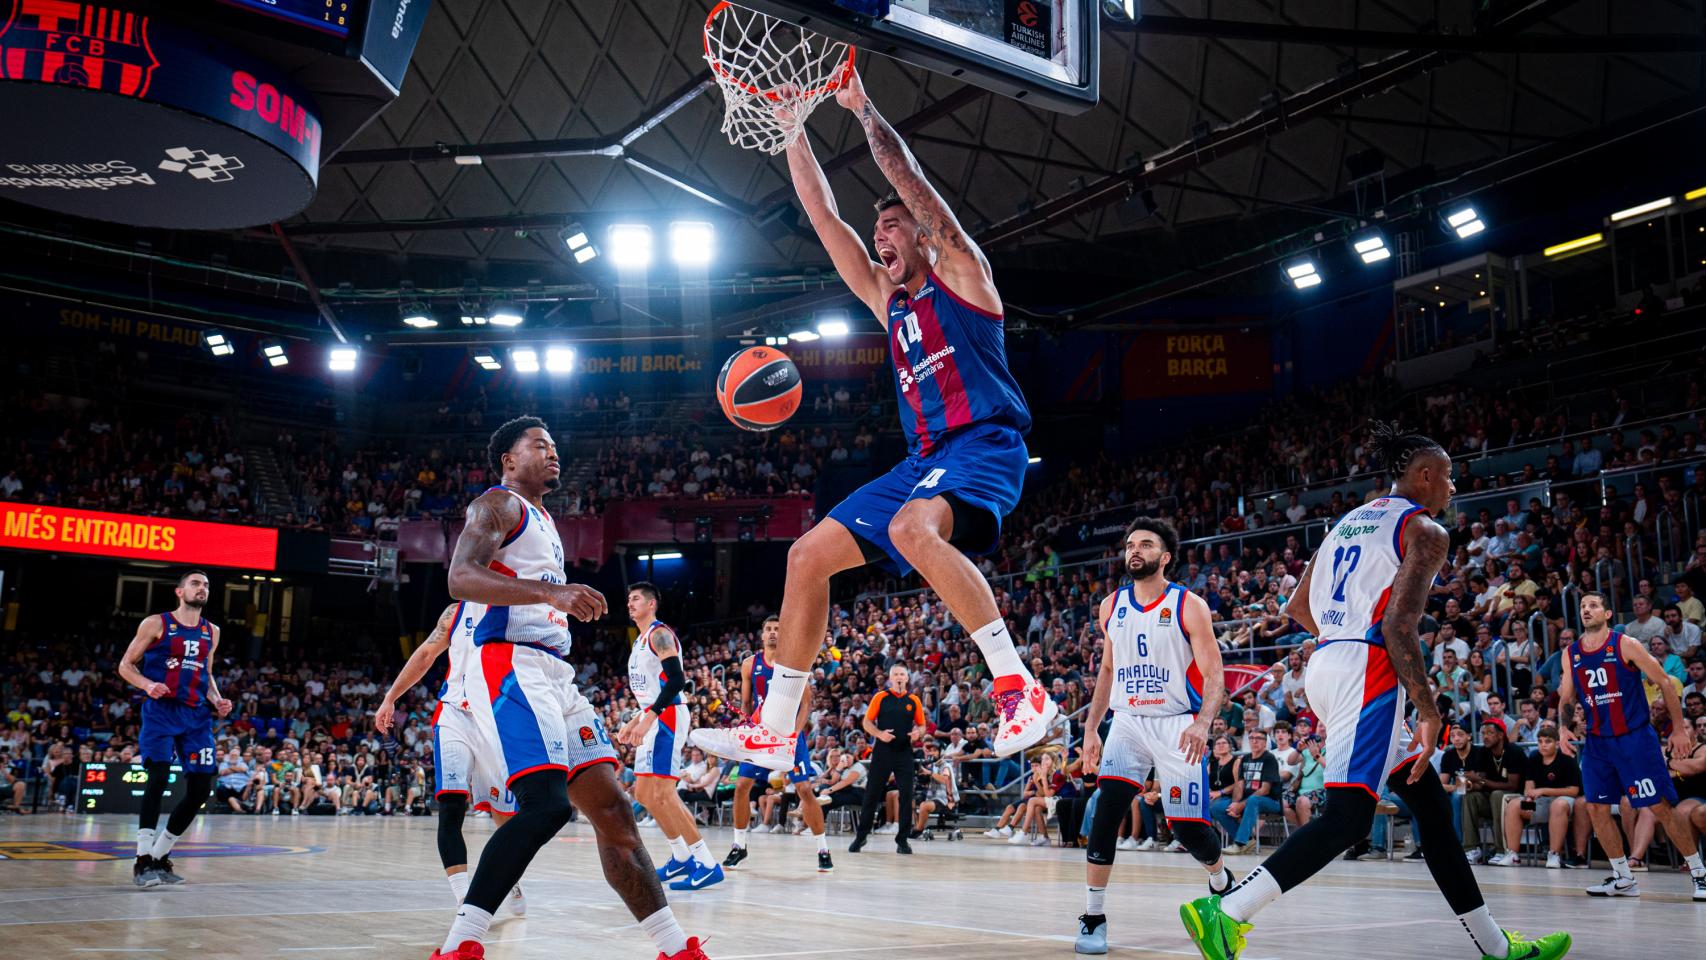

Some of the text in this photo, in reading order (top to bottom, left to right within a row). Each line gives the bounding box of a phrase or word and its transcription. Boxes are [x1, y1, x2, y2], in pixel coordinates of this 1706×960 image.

[1011, 22, 1045, 40] TURKISH
[1011, 31, 1045, 49] AIRLINES
[58, 308, 132, 337] SOM-HI
[897, 311, 923, 353] 14
[1167, 334, 1225, 356] FORÇA
[825, 348, 885, 365] PALAU!
[911, 345, 955, 375] Assistència
[914, 361, 944, 383] Sanitària
[1168, 358, 1228, 379] BARÇA
[917, 468, 947, 489] 4
[5, 508, 176, 551] MÉS ENTRADES
[1331, 545, 1361, 602] 12
[183, 640, 200, 657] 13
[1137, 633, 1148, 657] 6
[1117, 664, 1170, 683] ANADOLU
[1585, 667, 1608, 688] 20
[1126, 680, 1164, 694] EFES
[593, 718, 611, 745] 8
[199, 747, 214, 766] 13
[86, 770, 107, 783] 54
[1188, 781, 1199, 806] 6
[1634, 777, 1657, 798] 20
[87, 798, 97, 809] 2
